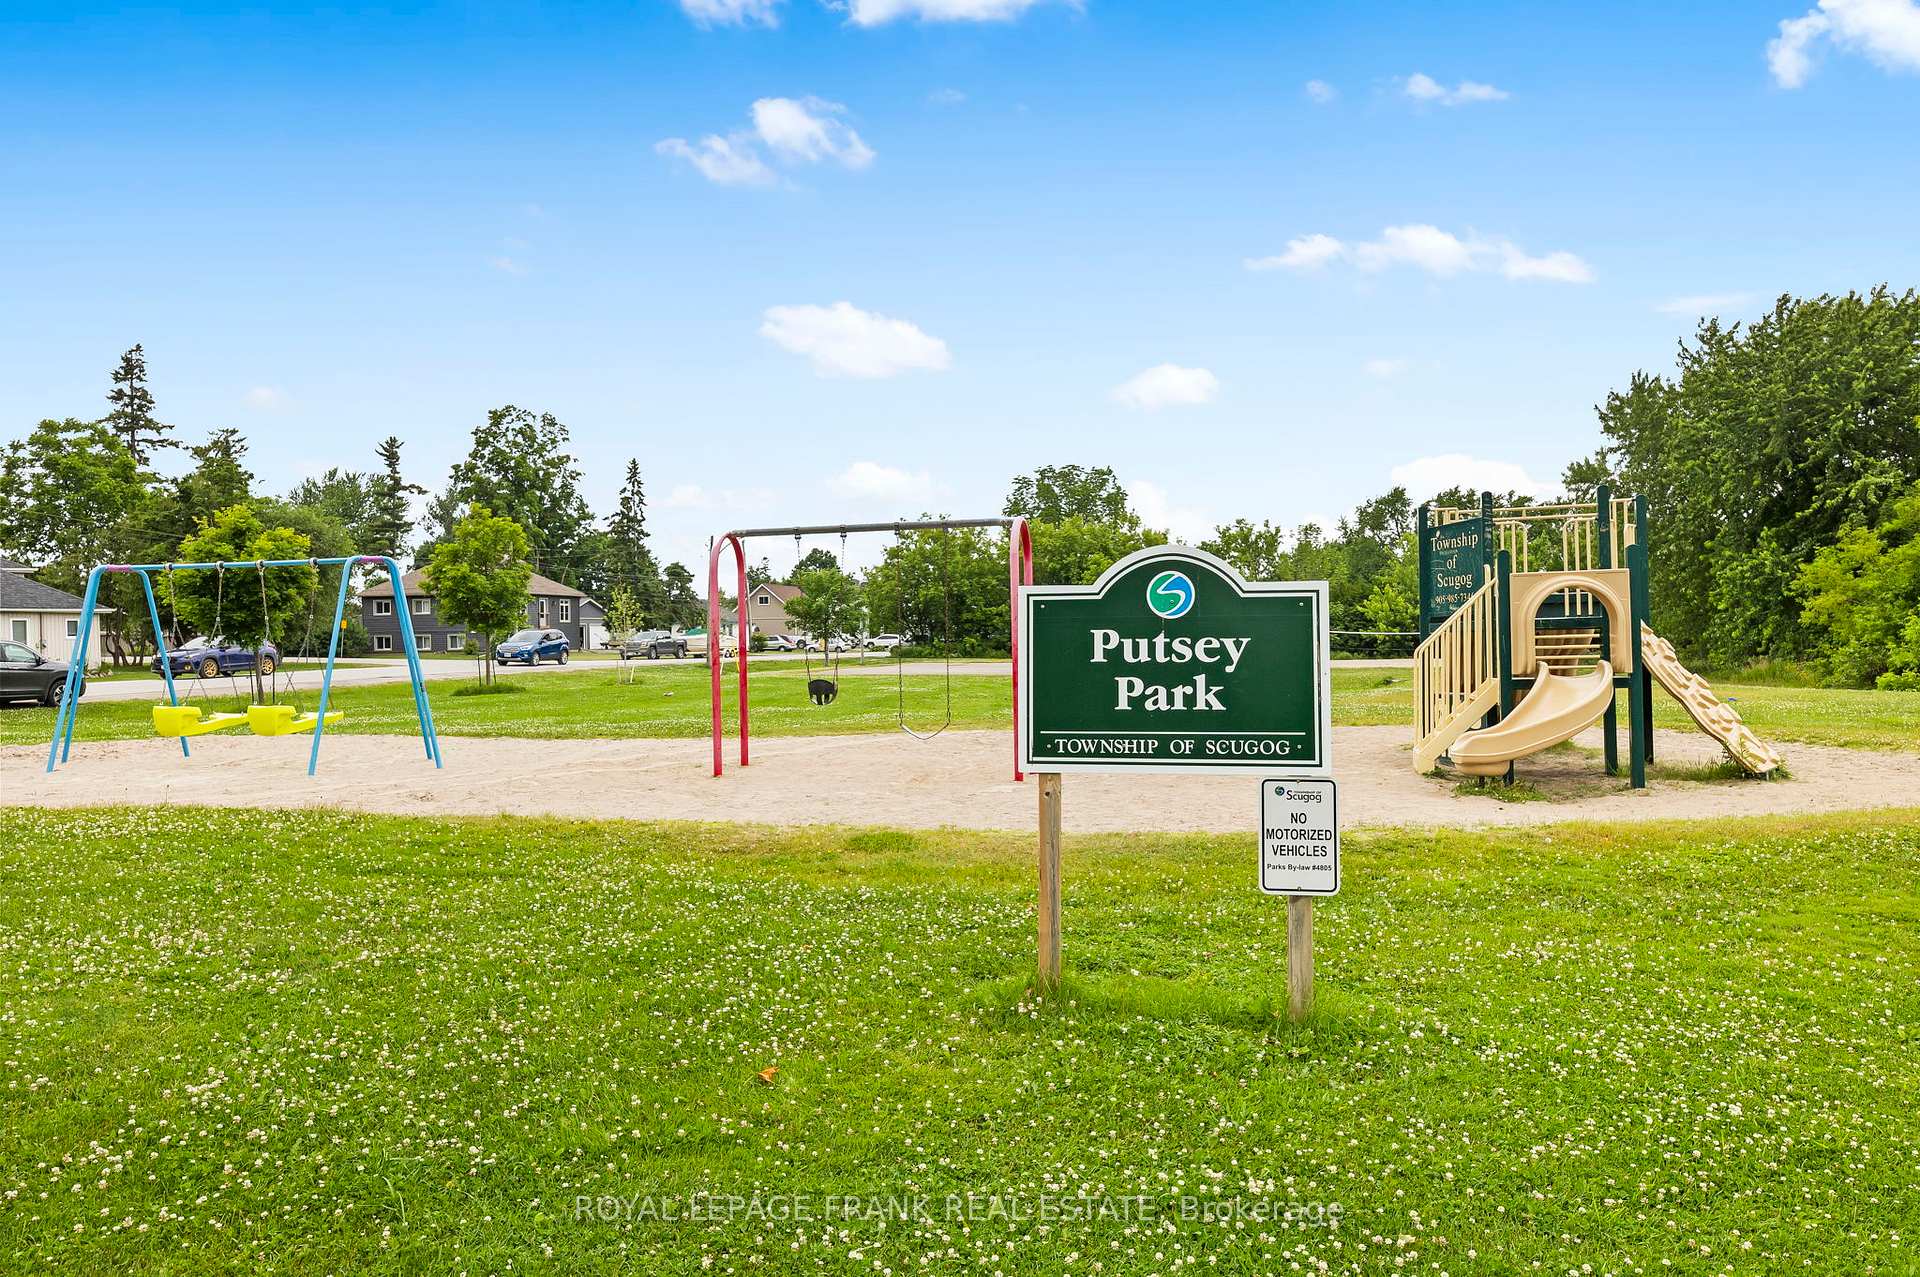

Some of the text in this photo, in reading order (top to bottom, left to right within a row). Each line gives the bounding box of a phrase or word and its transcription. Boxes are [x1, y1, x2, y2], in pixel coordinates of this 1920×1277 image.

[1430, 531, 1479, 551] Township
[1446, 554, 1458, 569] of
[1437, 573, 1473, 589] Scugog
[1090, 629, 1251, 673] Putsey
[1114, 674, 1226, 711] Park
[1055, 739, 1290, 755] TOWNSHIP OF SCUGOG
[1286, 790, 1322, 803] Scugog
[1290, 812, 1307, 824] NO
[1266, 828, 1332, 841] MOTORIZED
[1271, 844, 1328, 857] VEHICLES
[1287, 863, 1310, 872] By-law
